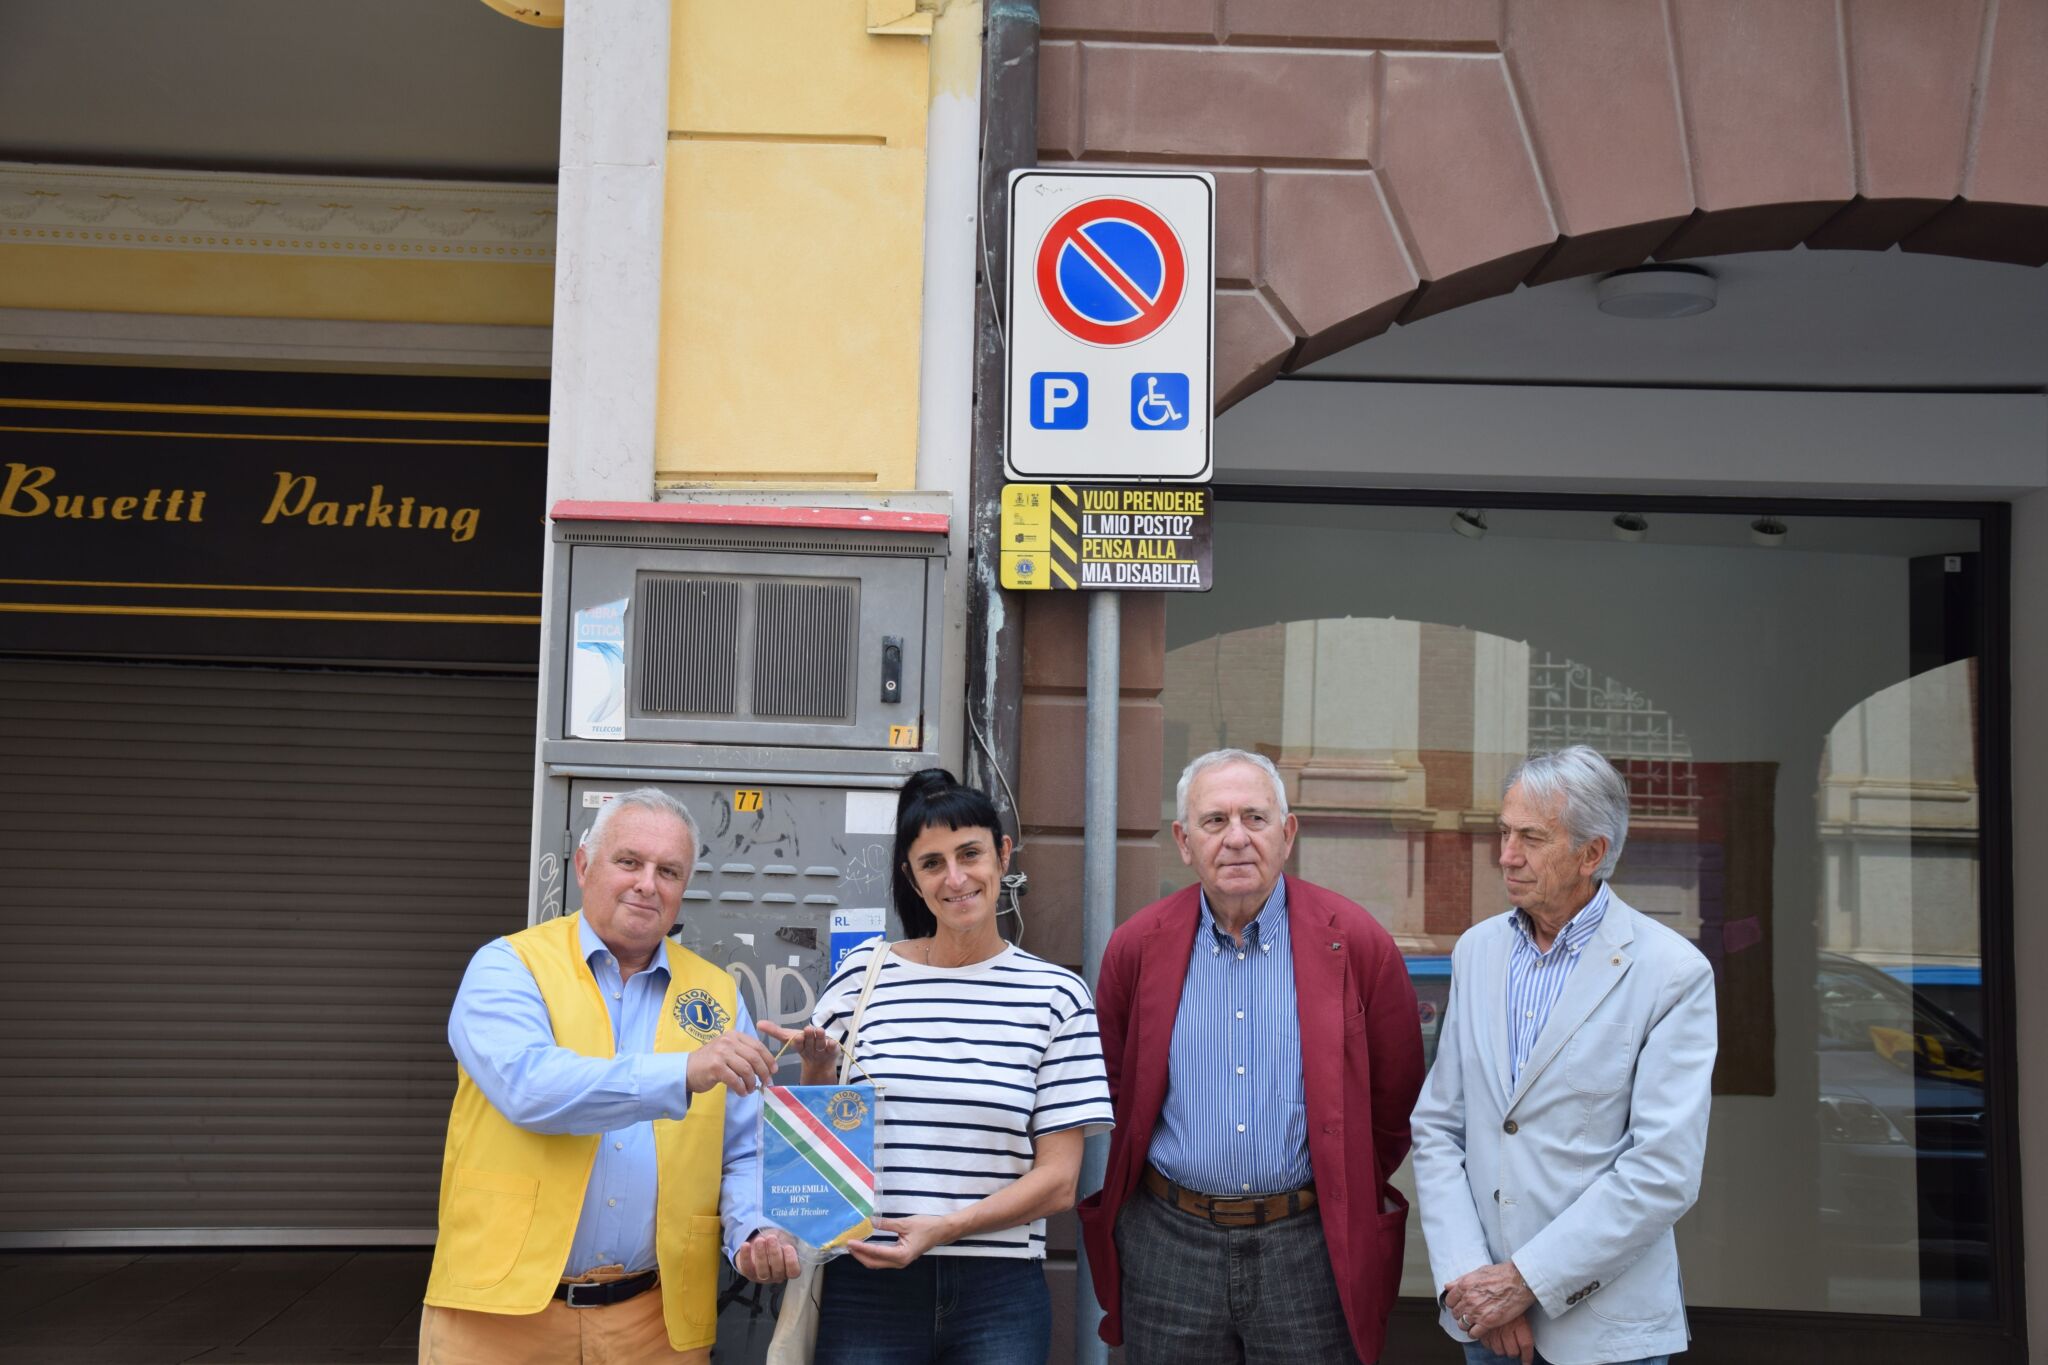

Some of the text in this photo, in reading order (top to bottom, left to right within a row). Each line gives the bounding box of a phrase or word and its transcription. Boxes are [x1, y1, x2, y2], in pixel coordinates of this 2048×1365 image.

[1043, 378, 1079, 423] P
[0, 463, 481, 542] Busetti Parking
[1082, 490, 1205, 512] VUOI PRENDERE
[1082, 515, 1193, 535] IL MIO POSTO?
[1082, 539, 1176, 560] PENSA ALLA
[1082, 563, 1112, 583] MIA
[581, 624, 622, 636] OTTICA
[592, 725, 622, 733] TELECOM
[738, 791, 760, 810] 77
[834, 916, 850, 927] RL
[680, 991, 713, 1005] LIONS
[694, 1004, 709, 1026] L
[843, 1103, 853, 1117] L
[771, 1184, 829, 1194] REGGIO EMILIA
[790, 1195, 810, 1204] HOST
[789, 1207, 800, 1217] del
[800, 1207, 829, 1217] Tricolore
